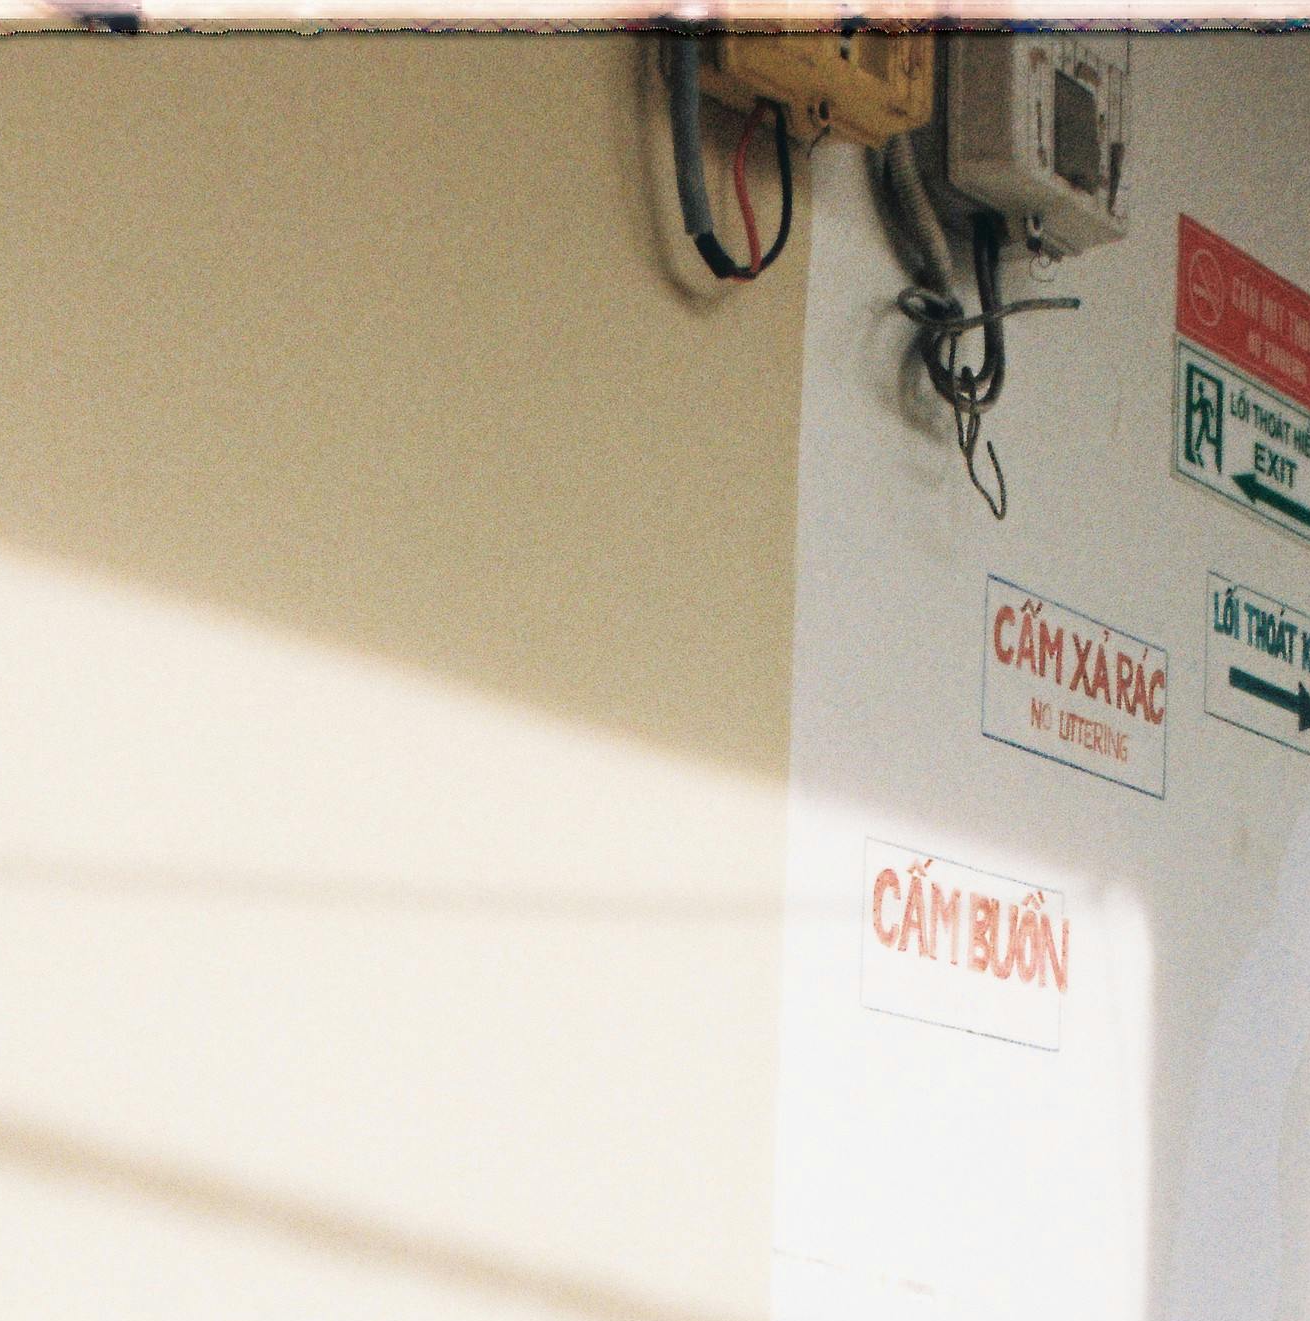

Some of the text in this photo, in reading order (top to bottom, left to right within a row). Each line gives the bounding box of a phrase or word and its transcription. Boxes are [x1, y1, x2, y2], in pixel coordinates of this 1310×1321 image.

[1254, 442, 1298, 488] EXIT
[994, 598, 1063, 685] CẤM
[1116, 647, 1165, 724] RÁC
[1244, 602, 1298, 664] THOÁT
[1031, 697, 1052, 731] NO
[873, 858, 961, 965] CẤM
